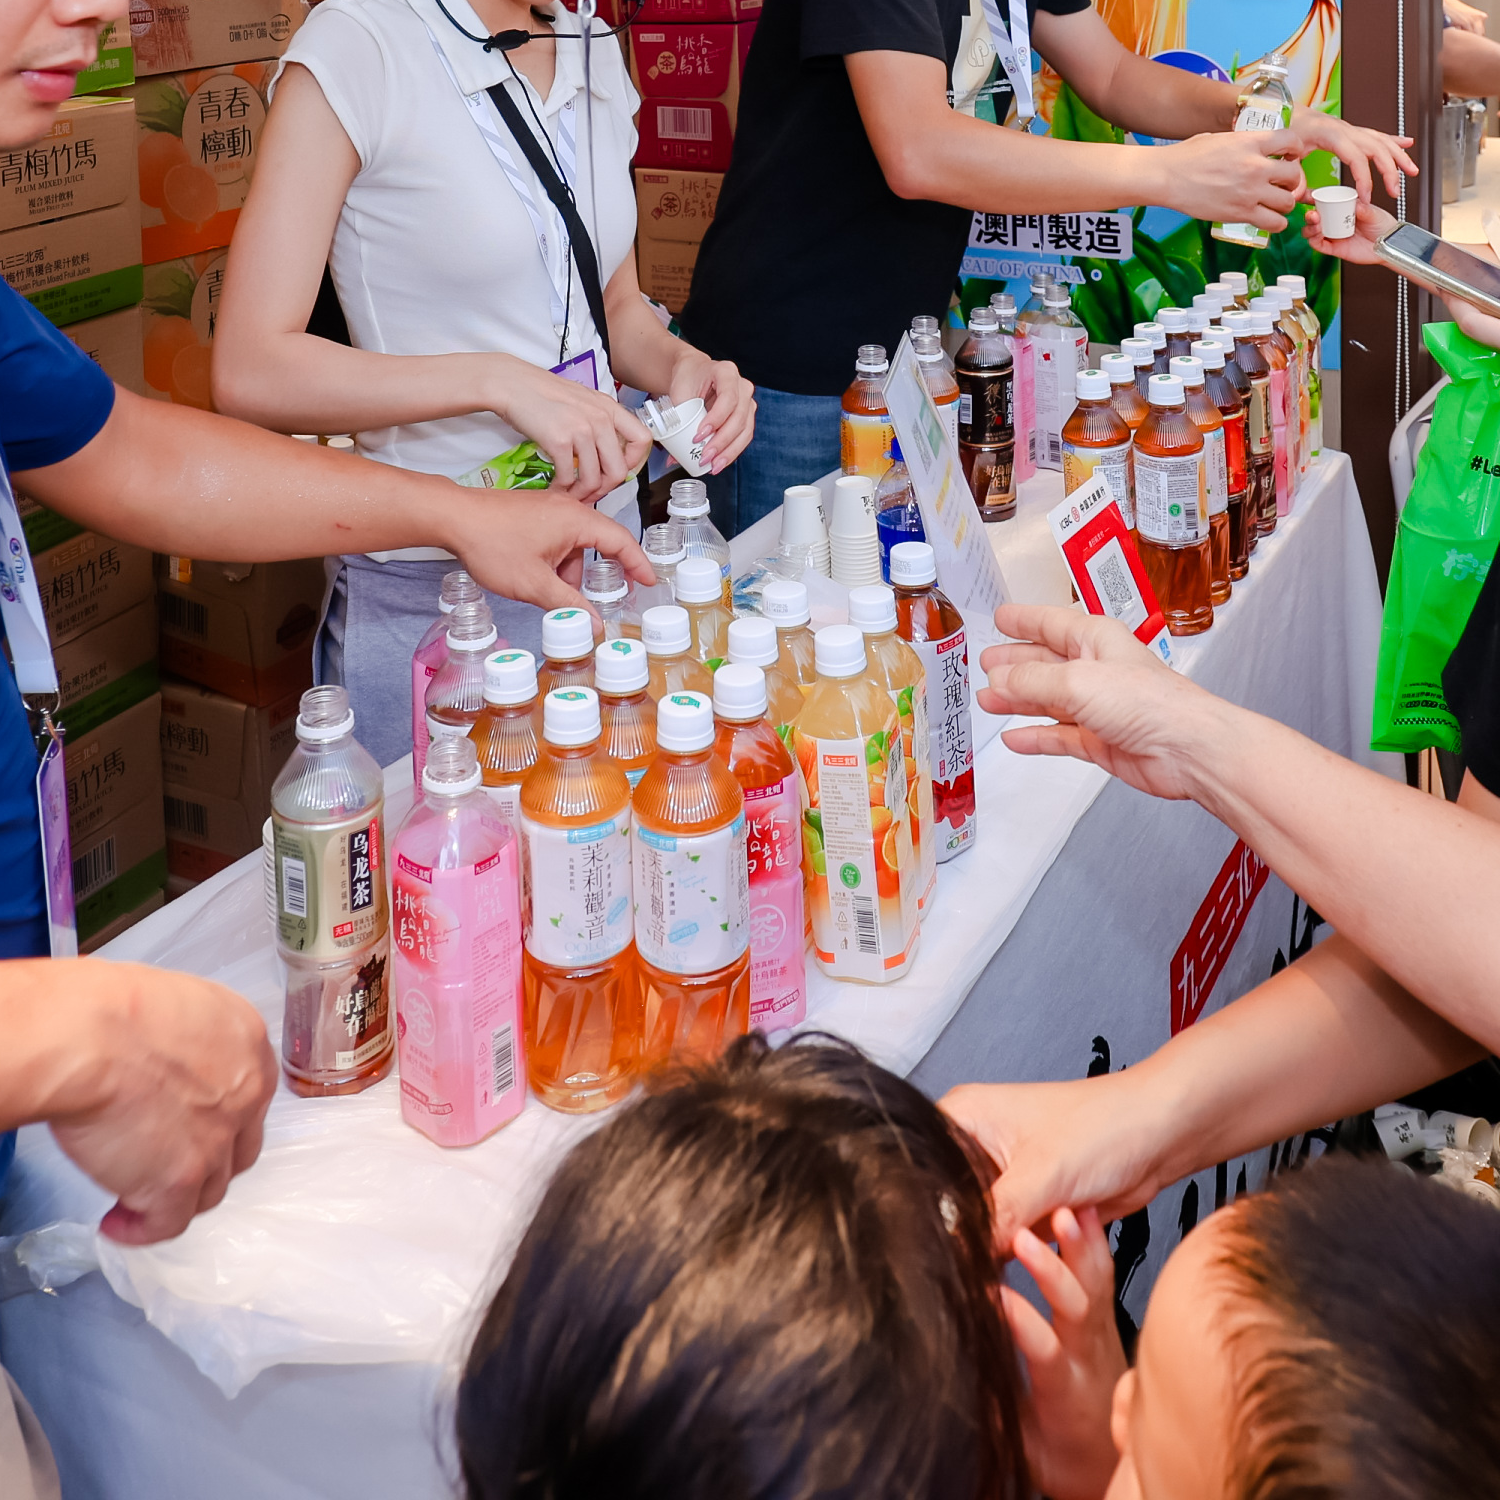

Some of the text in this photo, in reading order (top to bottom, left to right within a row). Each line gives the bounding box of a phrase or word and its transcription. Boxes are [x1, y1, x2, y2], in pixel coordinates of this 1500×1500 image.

[658, 53, 675, 72] 茶
[197, 86, 251, 124] 青春
[199, 124, 252, 164] 檸動
[0, 138, 97, 187] 青梅竹馬
[14, 173, 85, 195] PLUM MIXED JUICE
[662, 195, 679, 214] 茶
[974, 211, 1123, 255] 澳門製造
[3, 252, 90, 284] 梅竹馬複合果汁飲料
[77, 266, 91, 276] Juice
[999, 261, 1025, 277] OF
[1027, 263, 1086, 284] CHINA
[937, 632, 964, 655] 九三三北苑
[941, 651, 967, 776] 玫瑰紅茶
[823, 754, 859, 767] 九三三北苑
[744, 783, 782, 800] 三三北苑
[350, 833, 372, 908] 乌龙茶
[581, 842, 606, 941] 茉莉觀音
[647, 847, 666, 947] 茉莉觀音
[1177, 842, 1265, 1031] 九三三北
